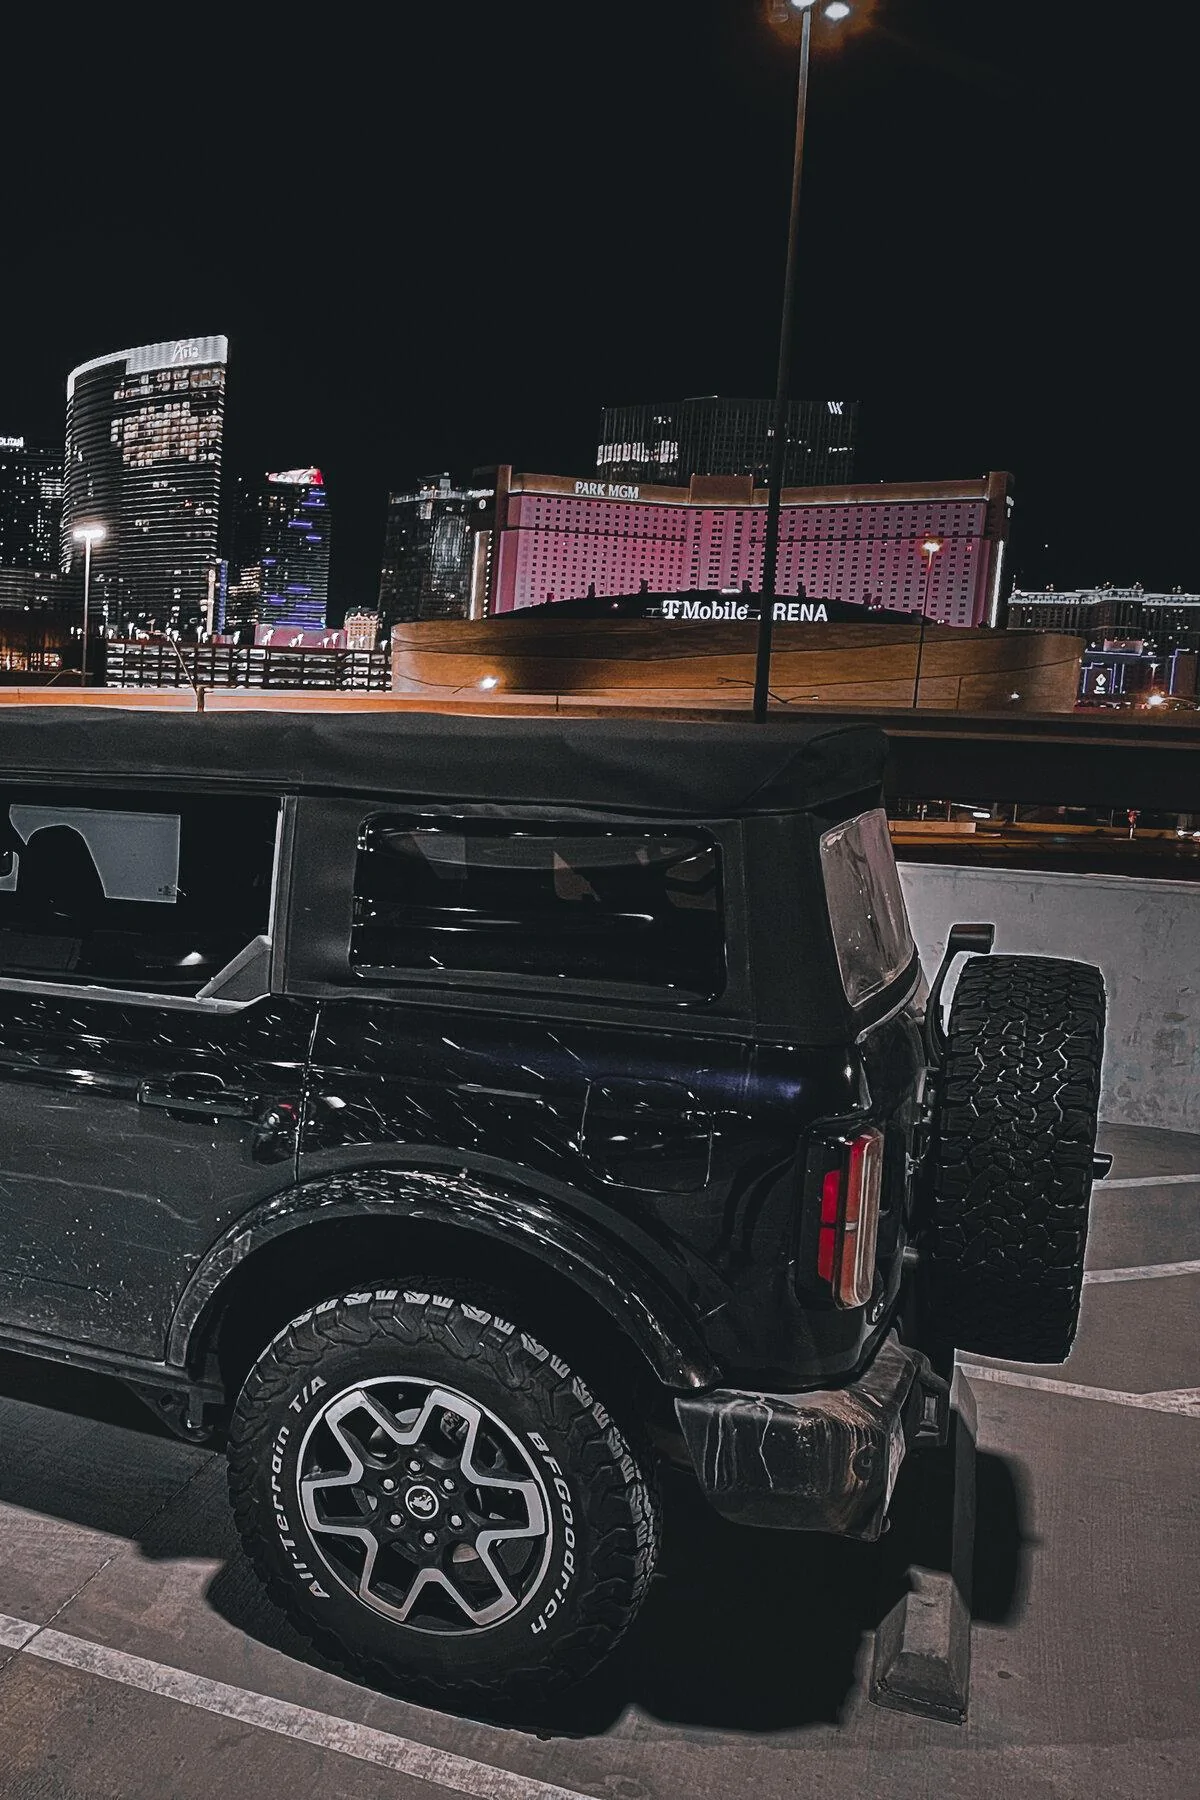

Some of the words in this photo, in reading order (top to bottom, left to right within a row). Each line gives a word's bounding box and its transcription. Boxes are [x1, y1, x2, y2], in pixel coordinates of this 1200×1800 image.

[575, 481, 604, 497] PARK
[608, 484, 639, 499] MGM
[757, 603, 828, 622] RENA
[288, 1376, 327, 1413] T/A
[271, 1426, 330, 1598] All-Terrain
[526, 1432, 576, 1634] BFGoodrich
